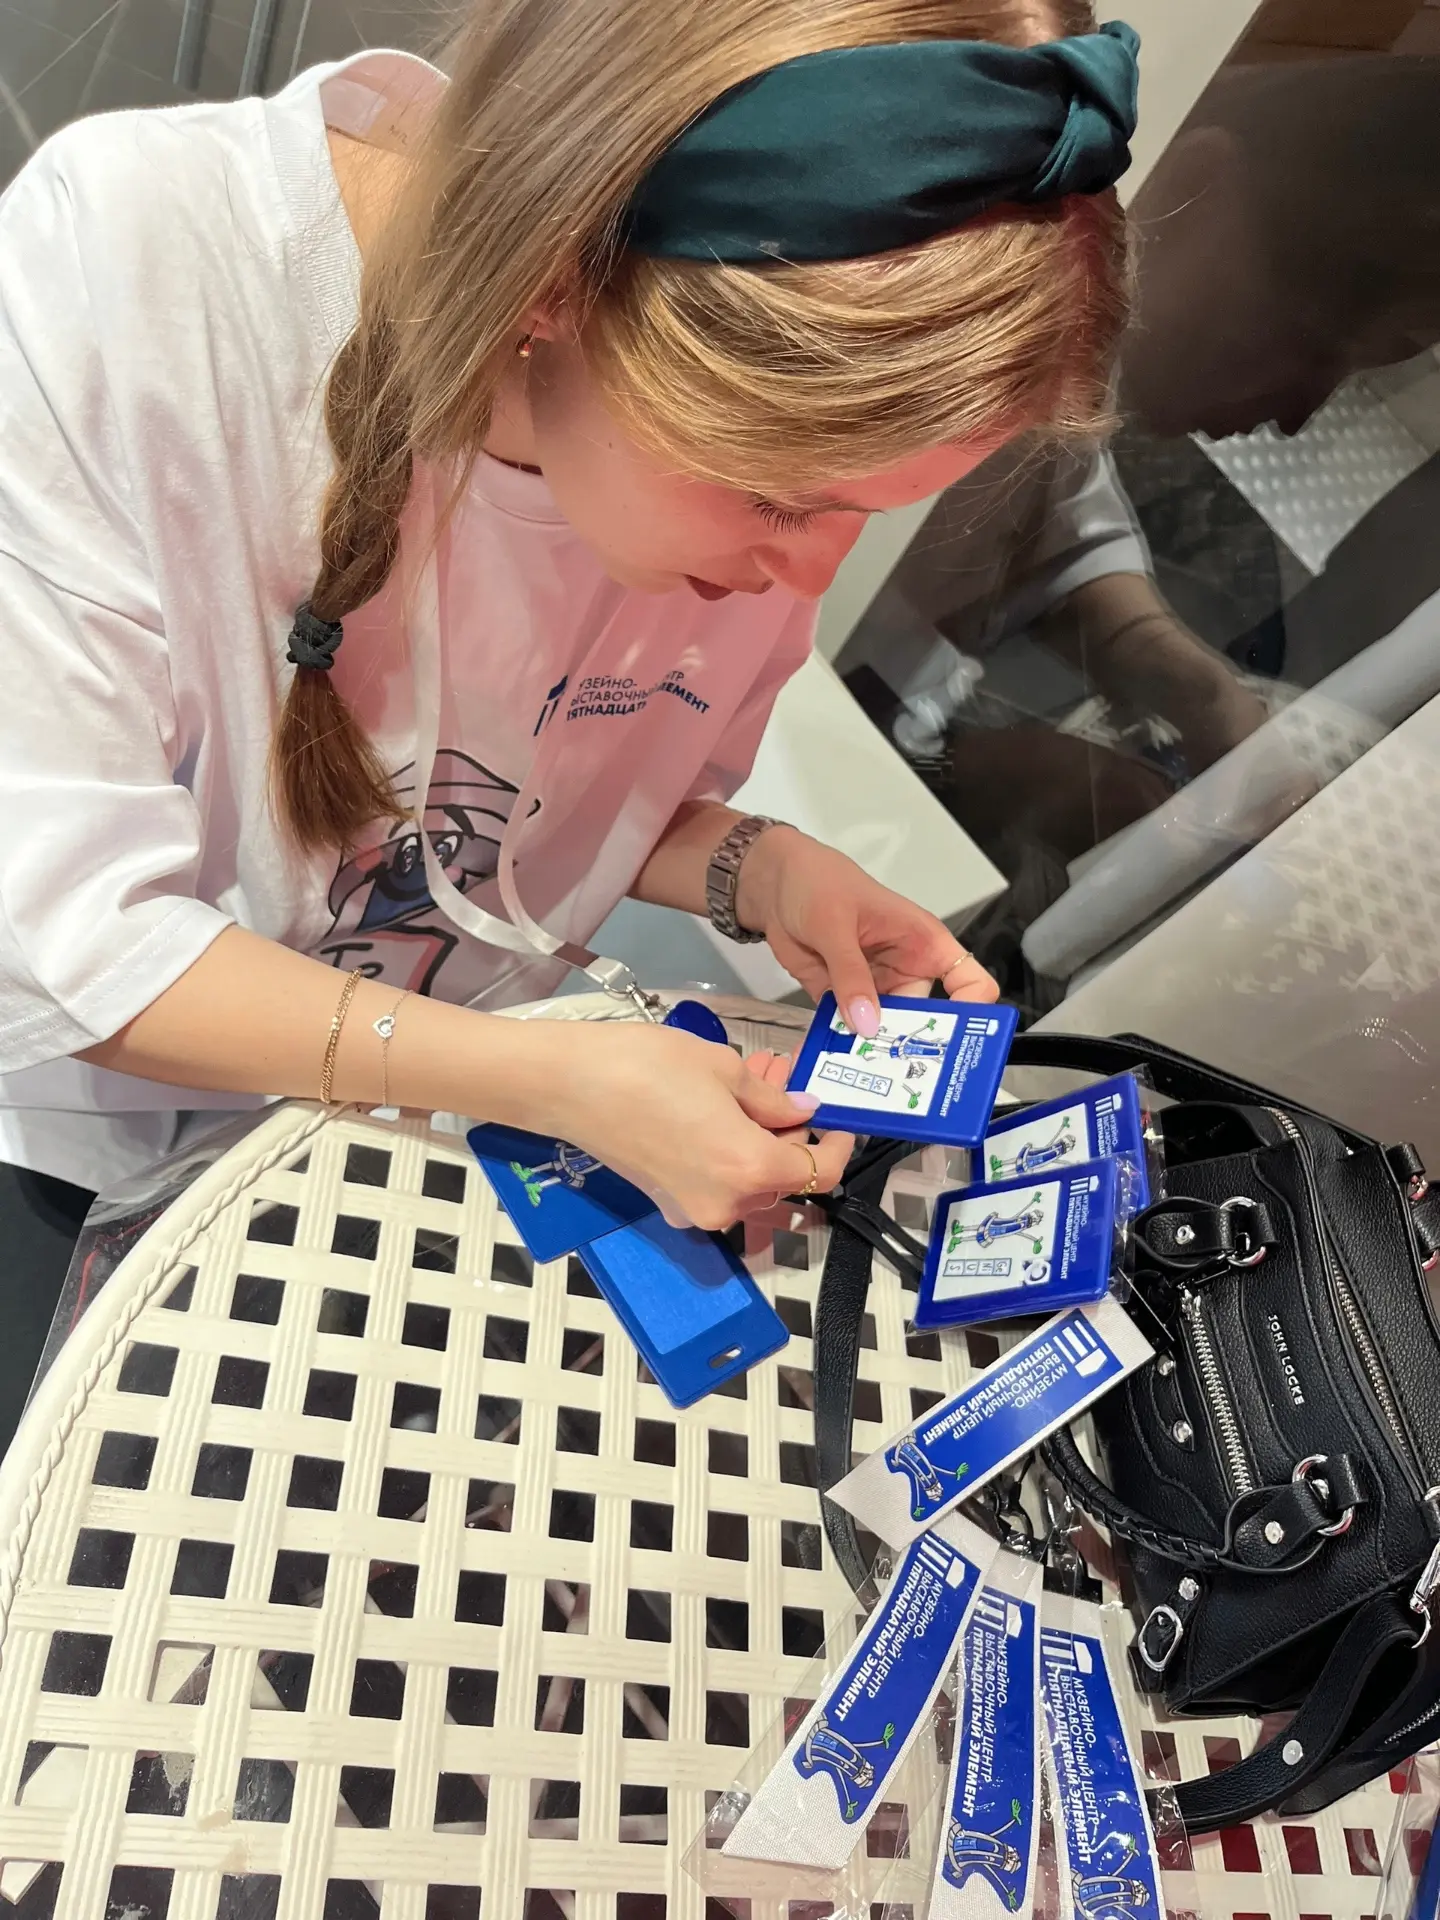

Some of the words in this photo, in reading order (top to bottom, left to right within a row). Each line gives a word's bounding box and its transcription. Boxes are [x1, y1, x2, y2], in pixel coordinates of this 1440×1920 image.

[571, 688, 650, 706] ЫСТАВОЧНЫ
[578, 675, 638, 691] УЗЕЙНО-
[967, 1342, 1053, 1410] ПЯТНАДЦАТЫЙ
[982, 1353, 1061, 1419] ВЫСТАВОЧНЫЙ
[1011, 1363, 1068, 1408] МУЗЕЙНО-
[1268, 1314, 1288, 1353] JOHN
[1281, 1356, 1305, 1405] LOCKE
[922, 1405, 969, 1446] ЭЛЕМЕНТ
[952, 1411, 983, 1440] ЦЕНТР
[872, 1560, 923, 1656] ПЯТНАДЦАТЫЙ
[889, 1571, 933, 1659] ВЫСТАВОЧНЫЙ
[913, 1579, 944, 1639] МУЗЕЙНО-
[834, 1653, 878, 1722] ЭЛЕМЕНТ
[868, 1656, 894, 1699] ЦЕНТР
[970, 1626, 984, 1738] ПЯТНАДЦАТЫЙ
[984, 1631, 997, 1735] ВЫСТАВОЧНЫЙ
[997, 1636, 1008, 1708] МУЗЕЙНО-
[1073, 1677, 1097, 1749] МУЗЕЙНО-
[962, 1741, 979, 1818] ЭЛЕМЕНТ
[981, 1735, 994, 1783] ЦЕНТР
[1047, 1672, 1078, 1788] ПЯТНАДЦАТЫЙ
[1069, 1788, 1092, 1865] ЭЛЕМЕНТ
[1059, 1674, 1094, 1777] ВЫСТАВОЧНЫЙ
[1080, 1778, 1100, 1825] ЦЕНТР
